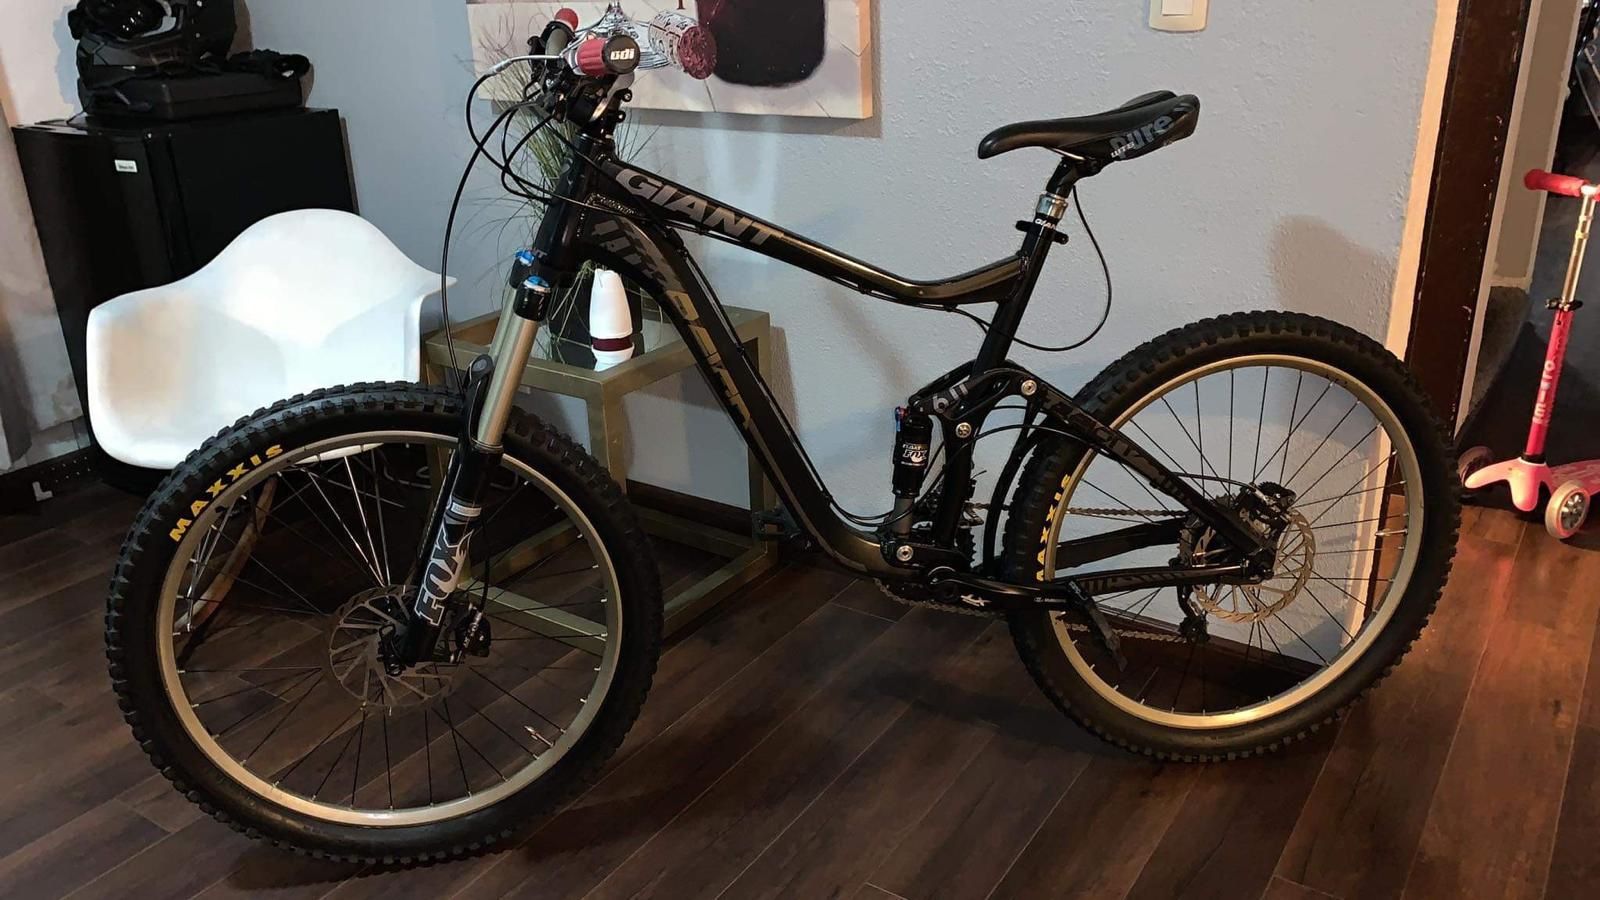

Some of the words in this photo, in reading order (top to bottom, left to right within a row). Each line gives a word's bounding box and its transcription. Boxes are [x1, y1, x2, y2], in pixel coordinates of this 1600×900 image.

[610, 48, 635, 61] odi
[615, 168, 785, 245] GIANT
[169, 444, 283, 542] MAXXIS
[414, 522, 475, 627] FOX
